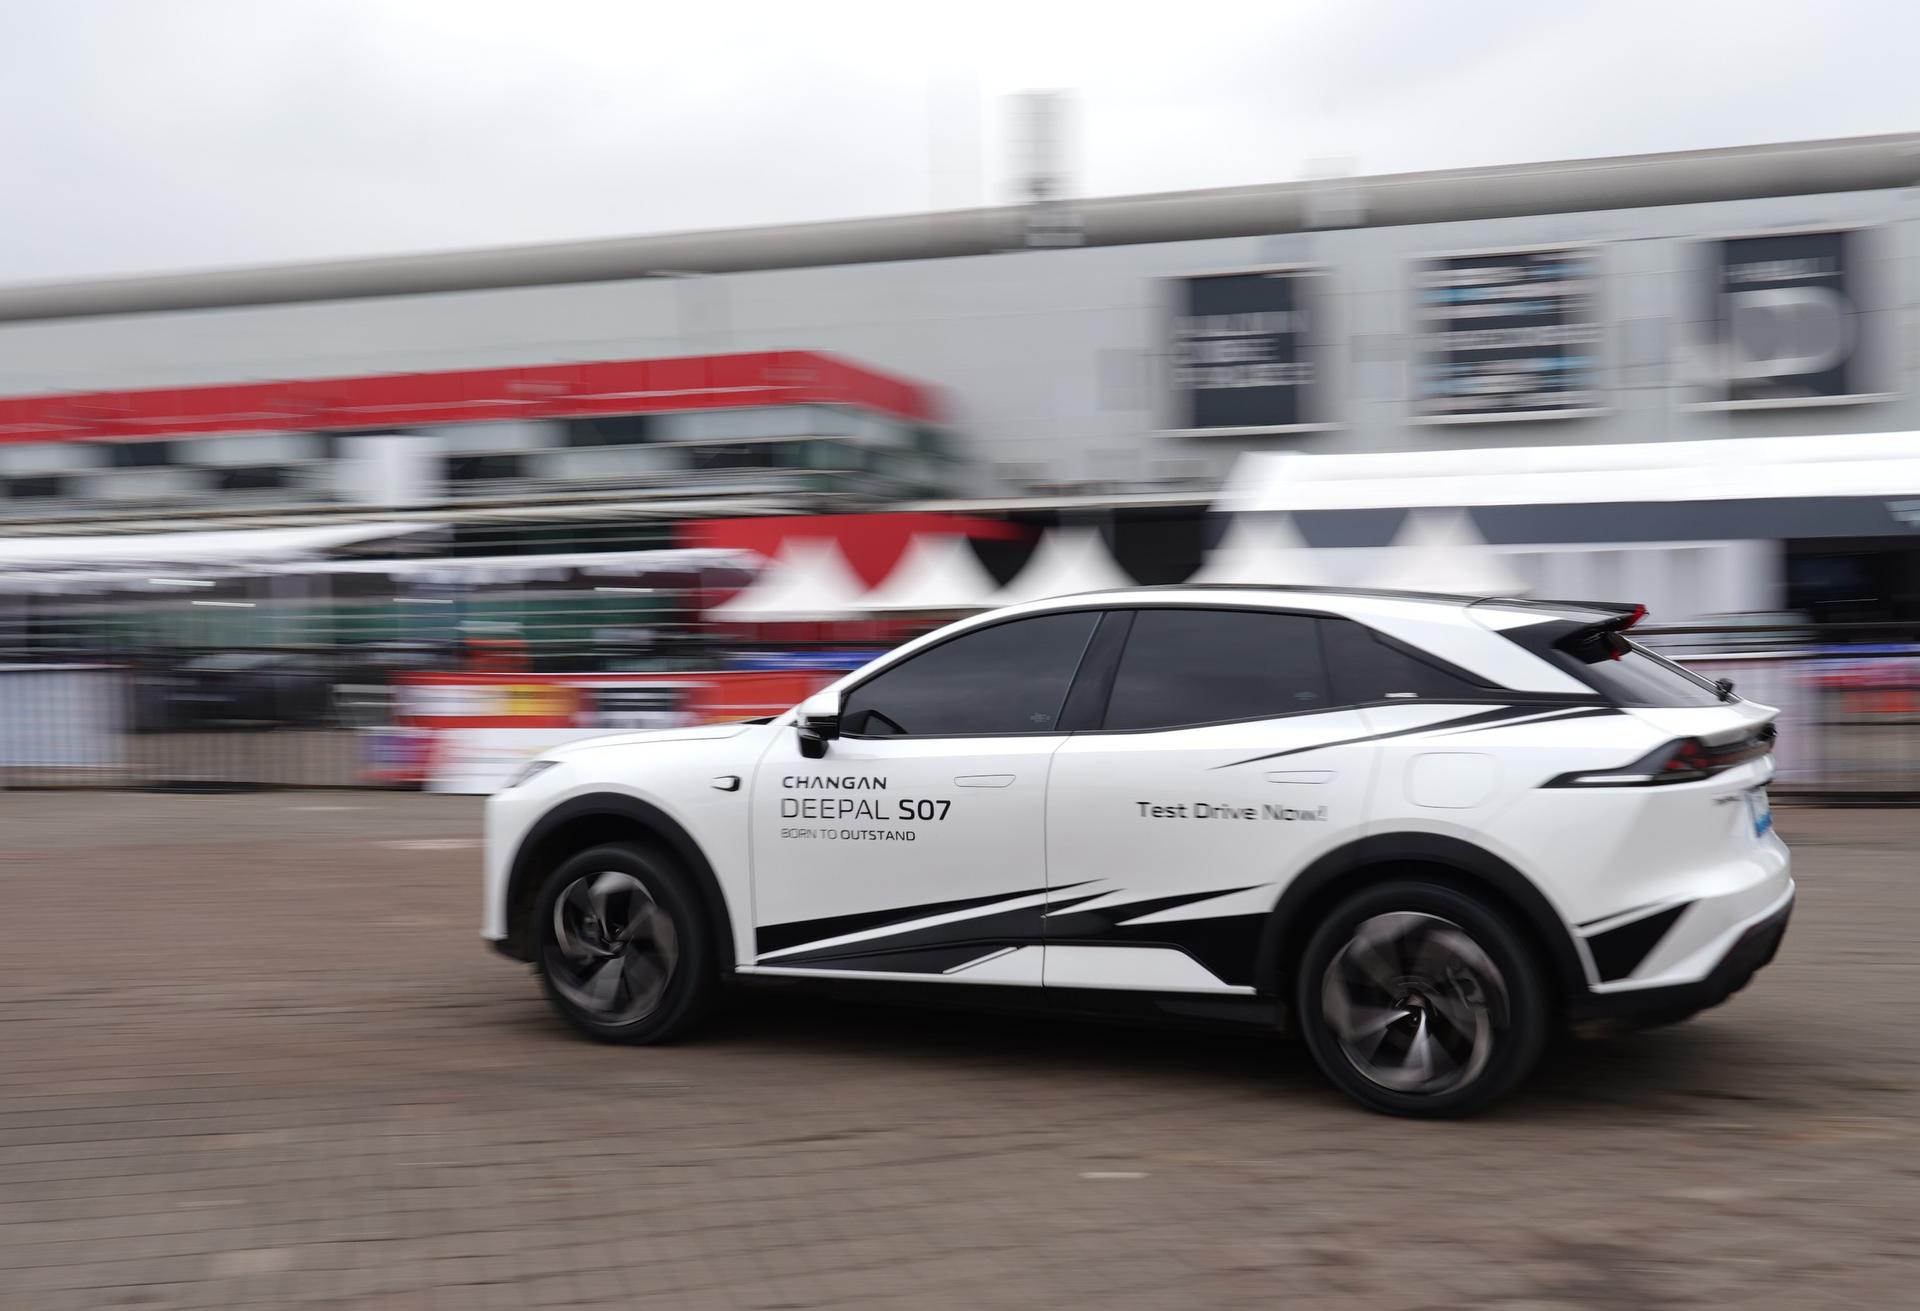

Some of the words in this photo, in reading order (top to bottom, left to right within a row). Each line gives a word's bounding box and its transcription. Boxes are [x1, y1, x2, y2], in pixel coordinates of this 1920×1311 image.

[782, 776, 887, 790] CHANGAN
[781, 798, 890, 820] DEEPAL
[898, 799, 951, 821] S07
[1136, 801, 1188, 819] Test
[1193, 802, 1257, 820] Drive
[781, 828, 818, 840] BORN
[820, 829, 839, 840] TO
[840, 829, 916, 841] OUTSTAND
